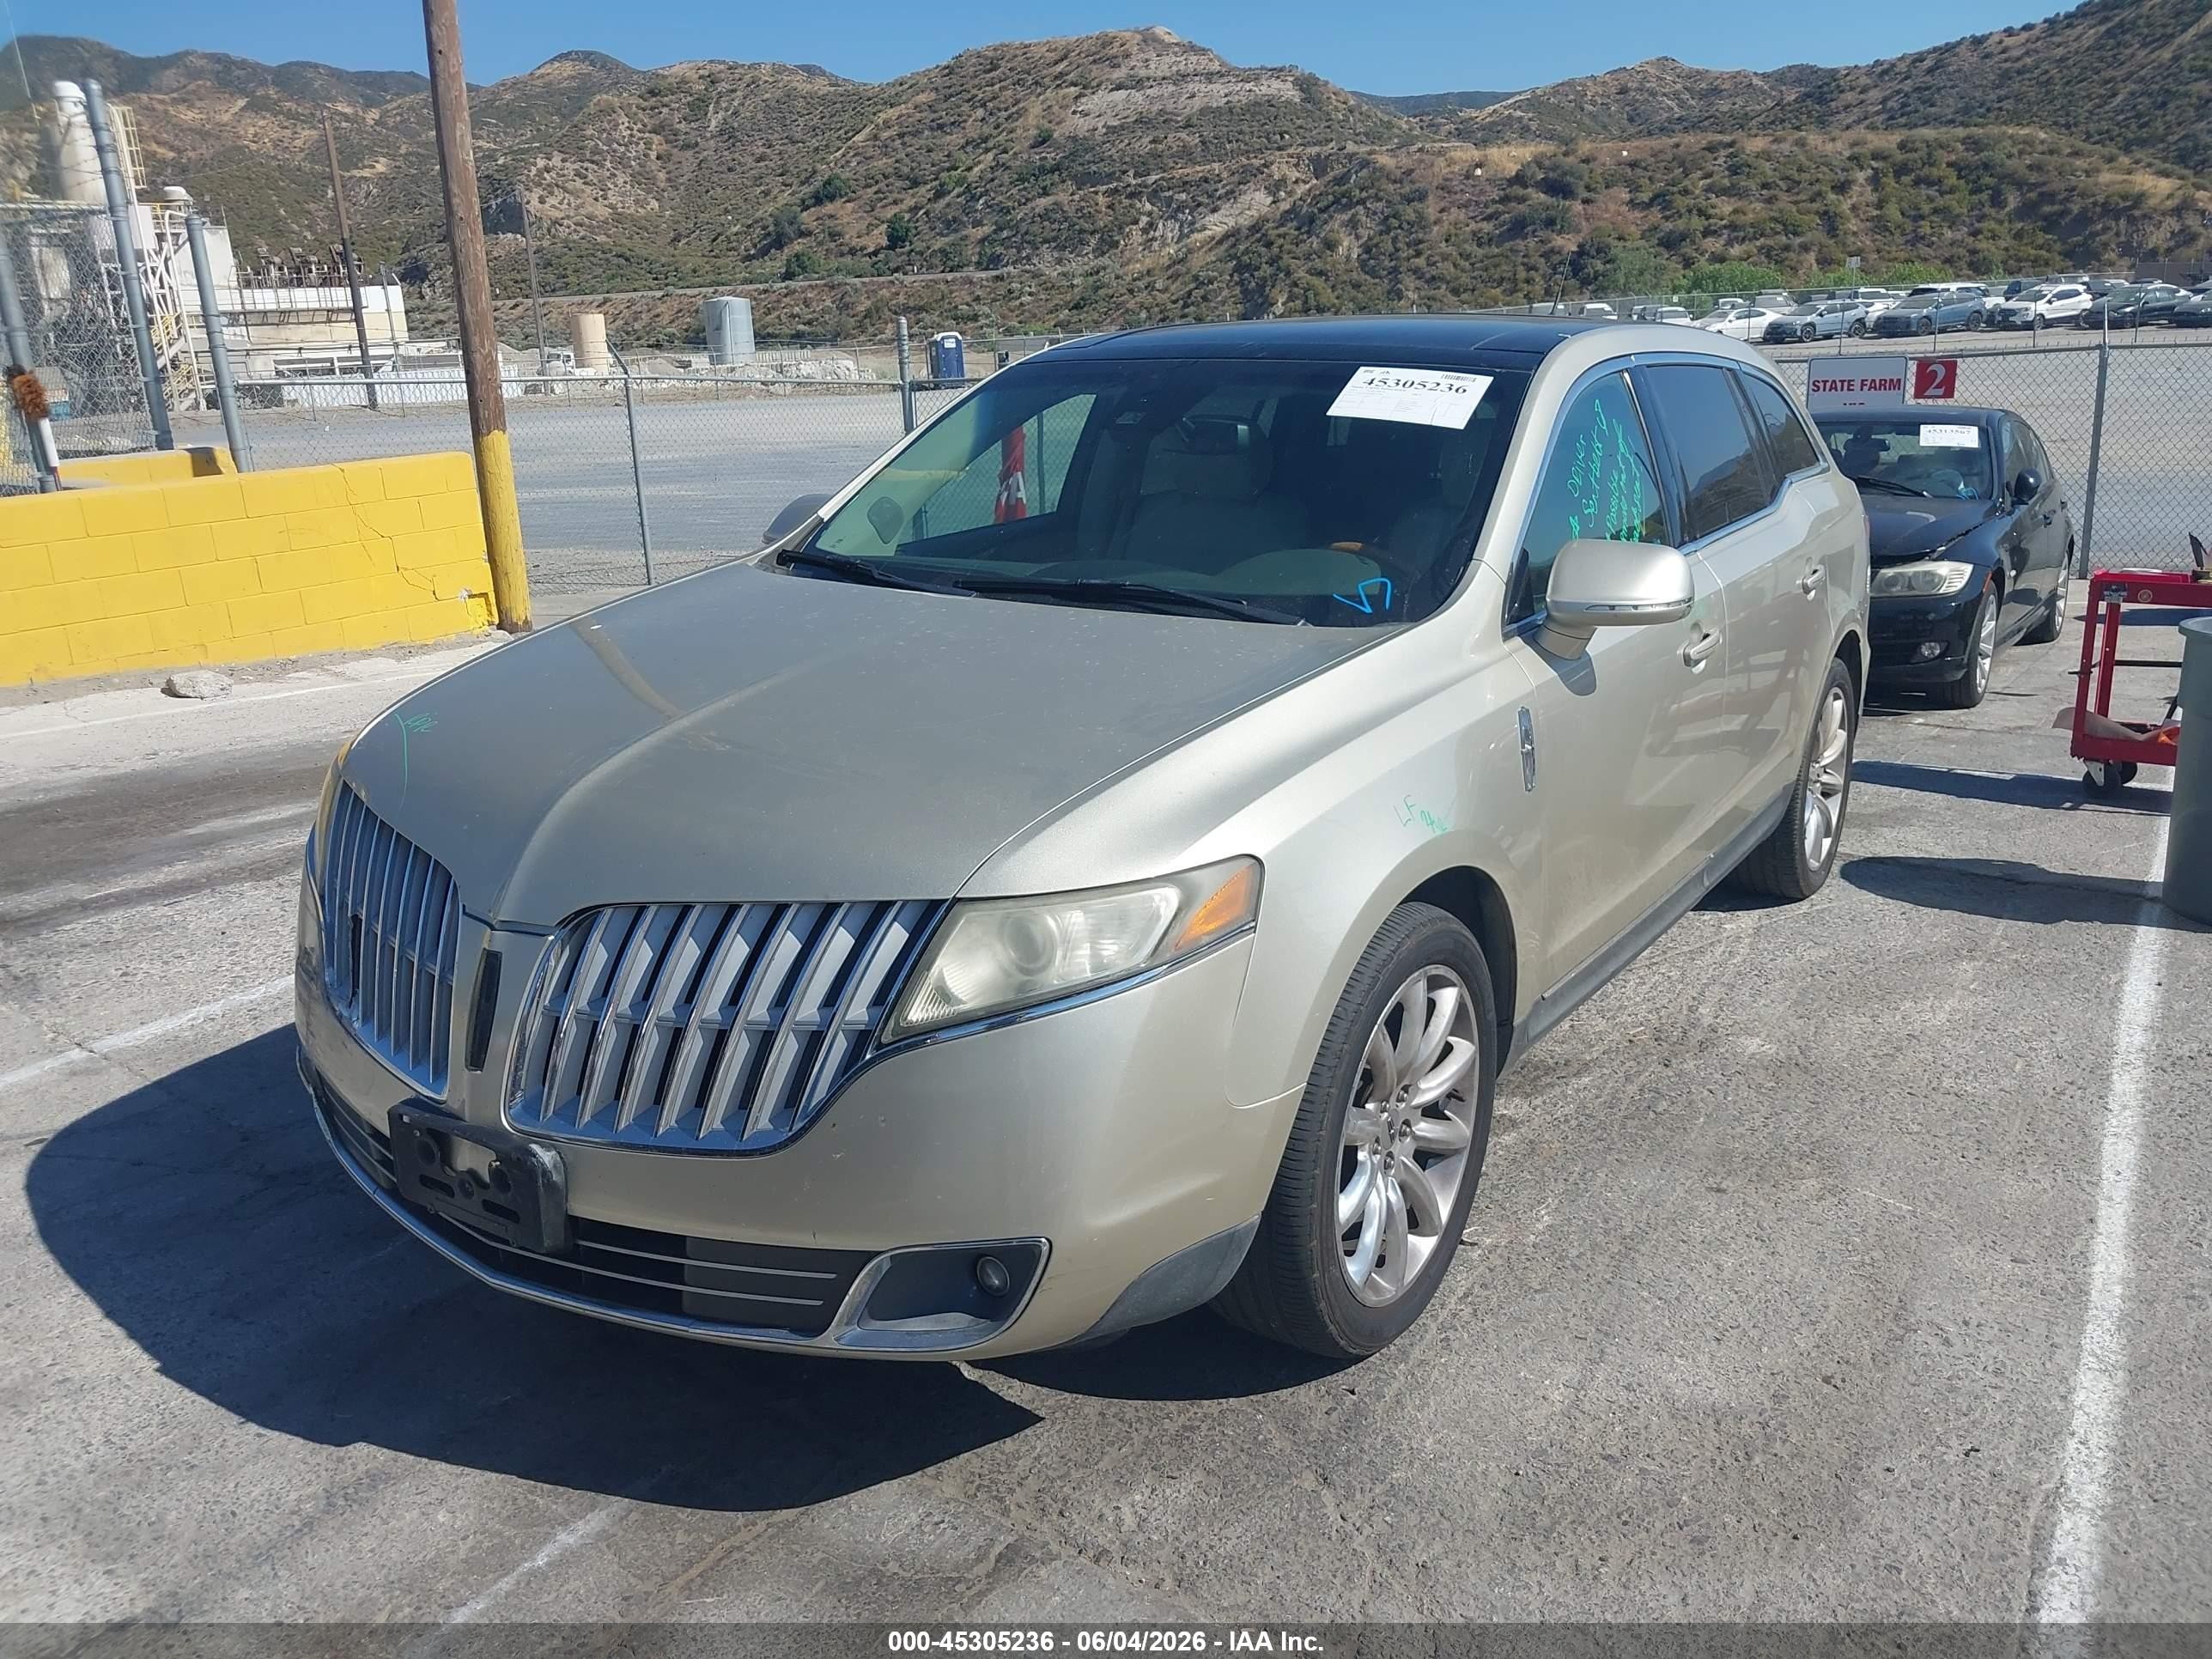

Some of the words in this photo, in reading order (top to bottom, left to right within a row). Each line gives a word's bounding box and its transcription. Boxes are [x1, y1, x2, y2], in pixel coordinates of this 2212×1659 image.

[1362, 377, 1468, 394] 45305236
[1811, 380, 1855, 392] STATE
[1860, 379, 1901, 392] FARM
[1923, 363, 1946, 396] 2
